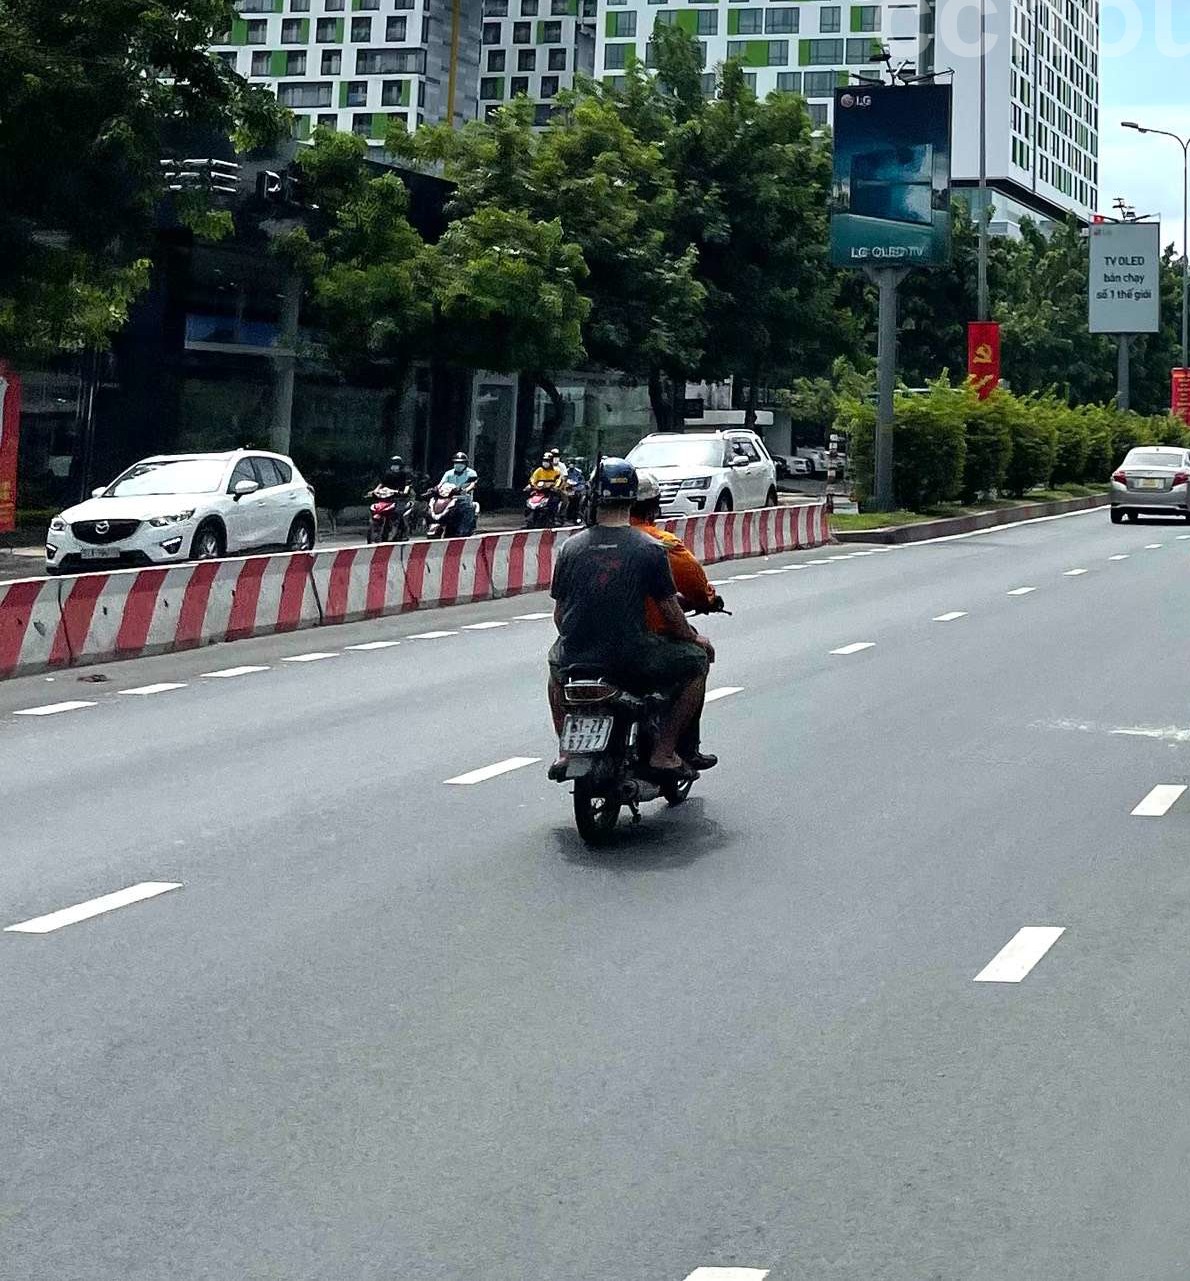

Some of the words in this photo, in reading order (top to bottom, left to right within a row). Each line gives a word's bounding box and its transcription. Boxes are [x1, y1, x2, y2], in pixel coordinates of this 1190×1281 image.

[856, 95, 872, 106] LG
[851, 247, 868, 257] LG
[872, 247, 906, 257] OLED
[1104, 256, 1117, 266] TV
[1119, 256, 1145, 266] OLED
